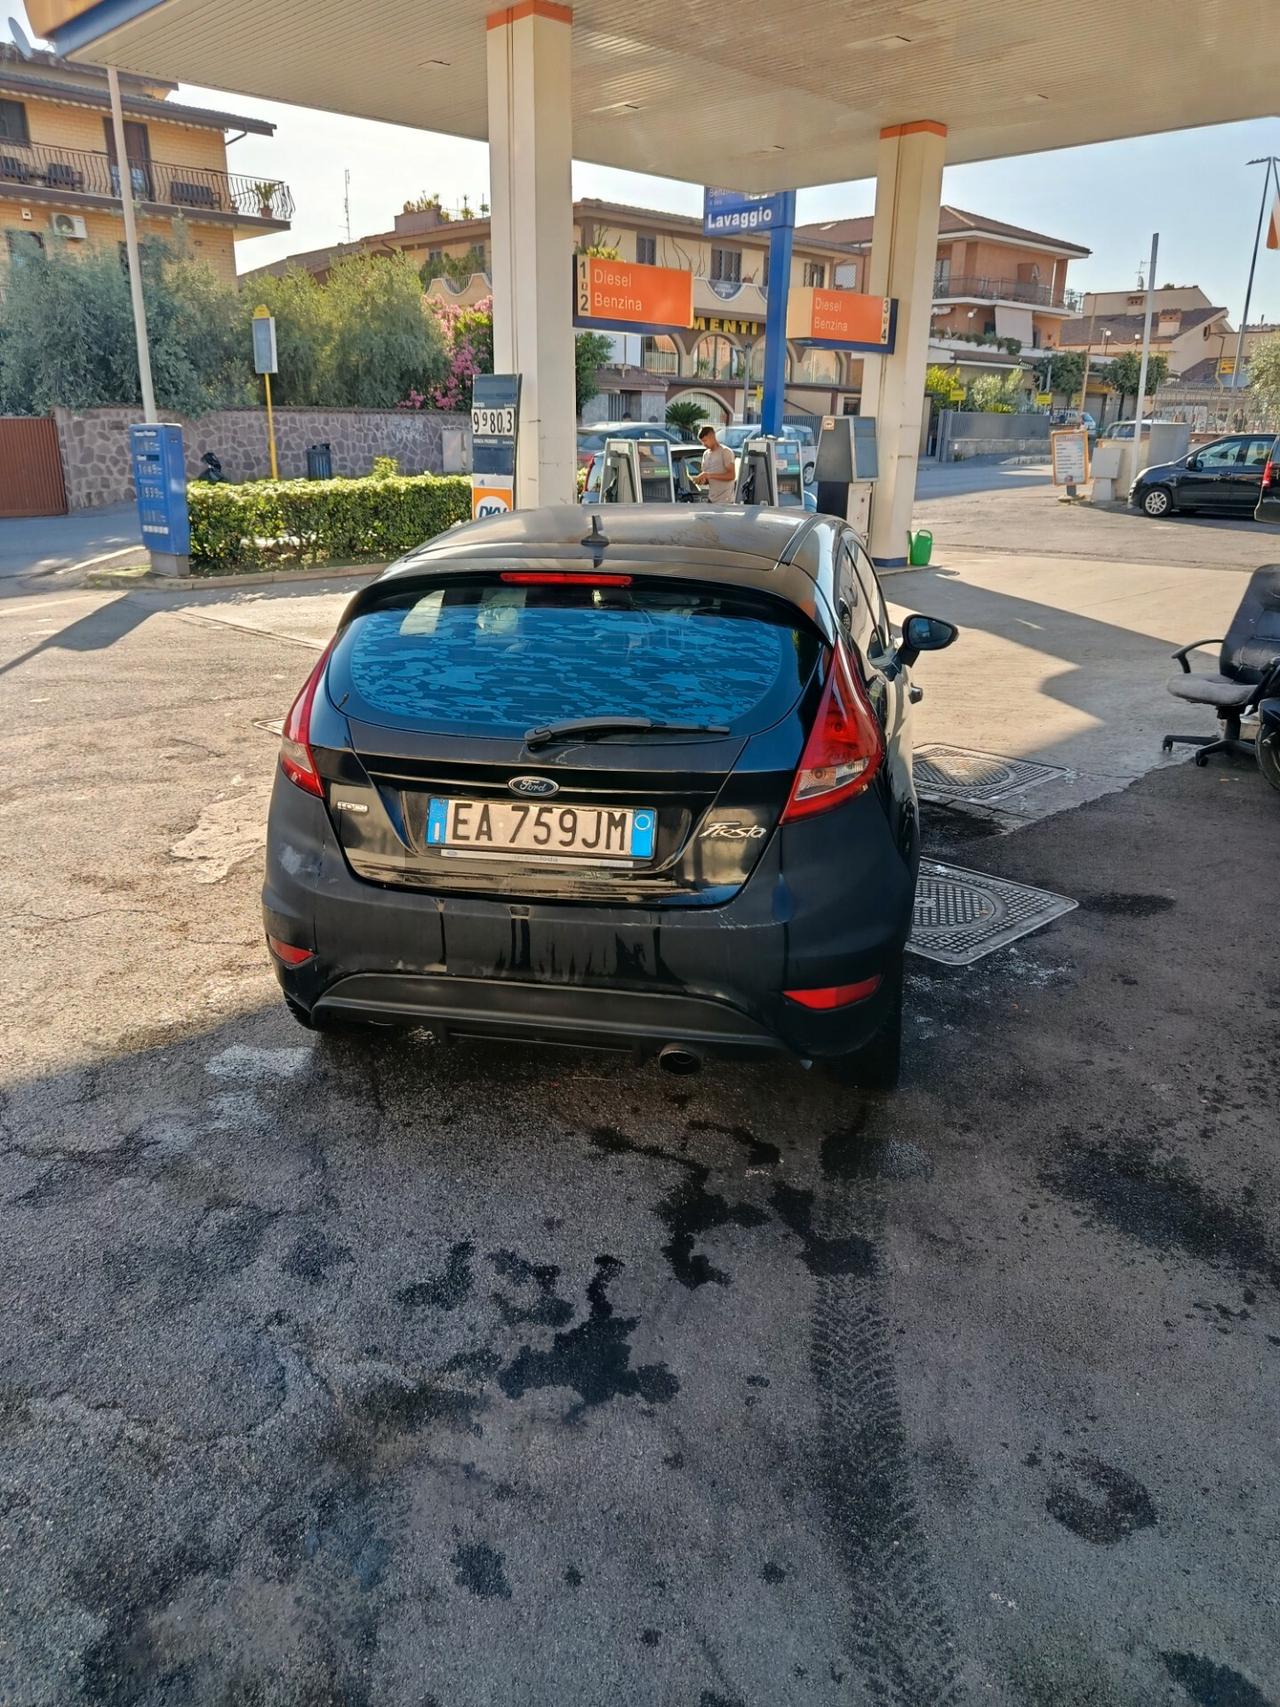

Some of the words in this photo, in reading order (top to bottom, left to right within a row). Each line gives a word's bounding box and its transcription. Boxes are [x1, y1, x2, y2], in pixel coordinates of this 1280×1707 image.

[708, 206, 772, 229] Lavaggio
[594, 269, 632, 288] Diesel
[594, 292, 642, 312] Benzina
[815, 297, 842, 313] Diesel
[814, 316, 848, 333] Benzina
[520, 780, 548, 792] Ford
[452, 803, 493, 841] EA
[699, 821, 767, 839] Fiesta
